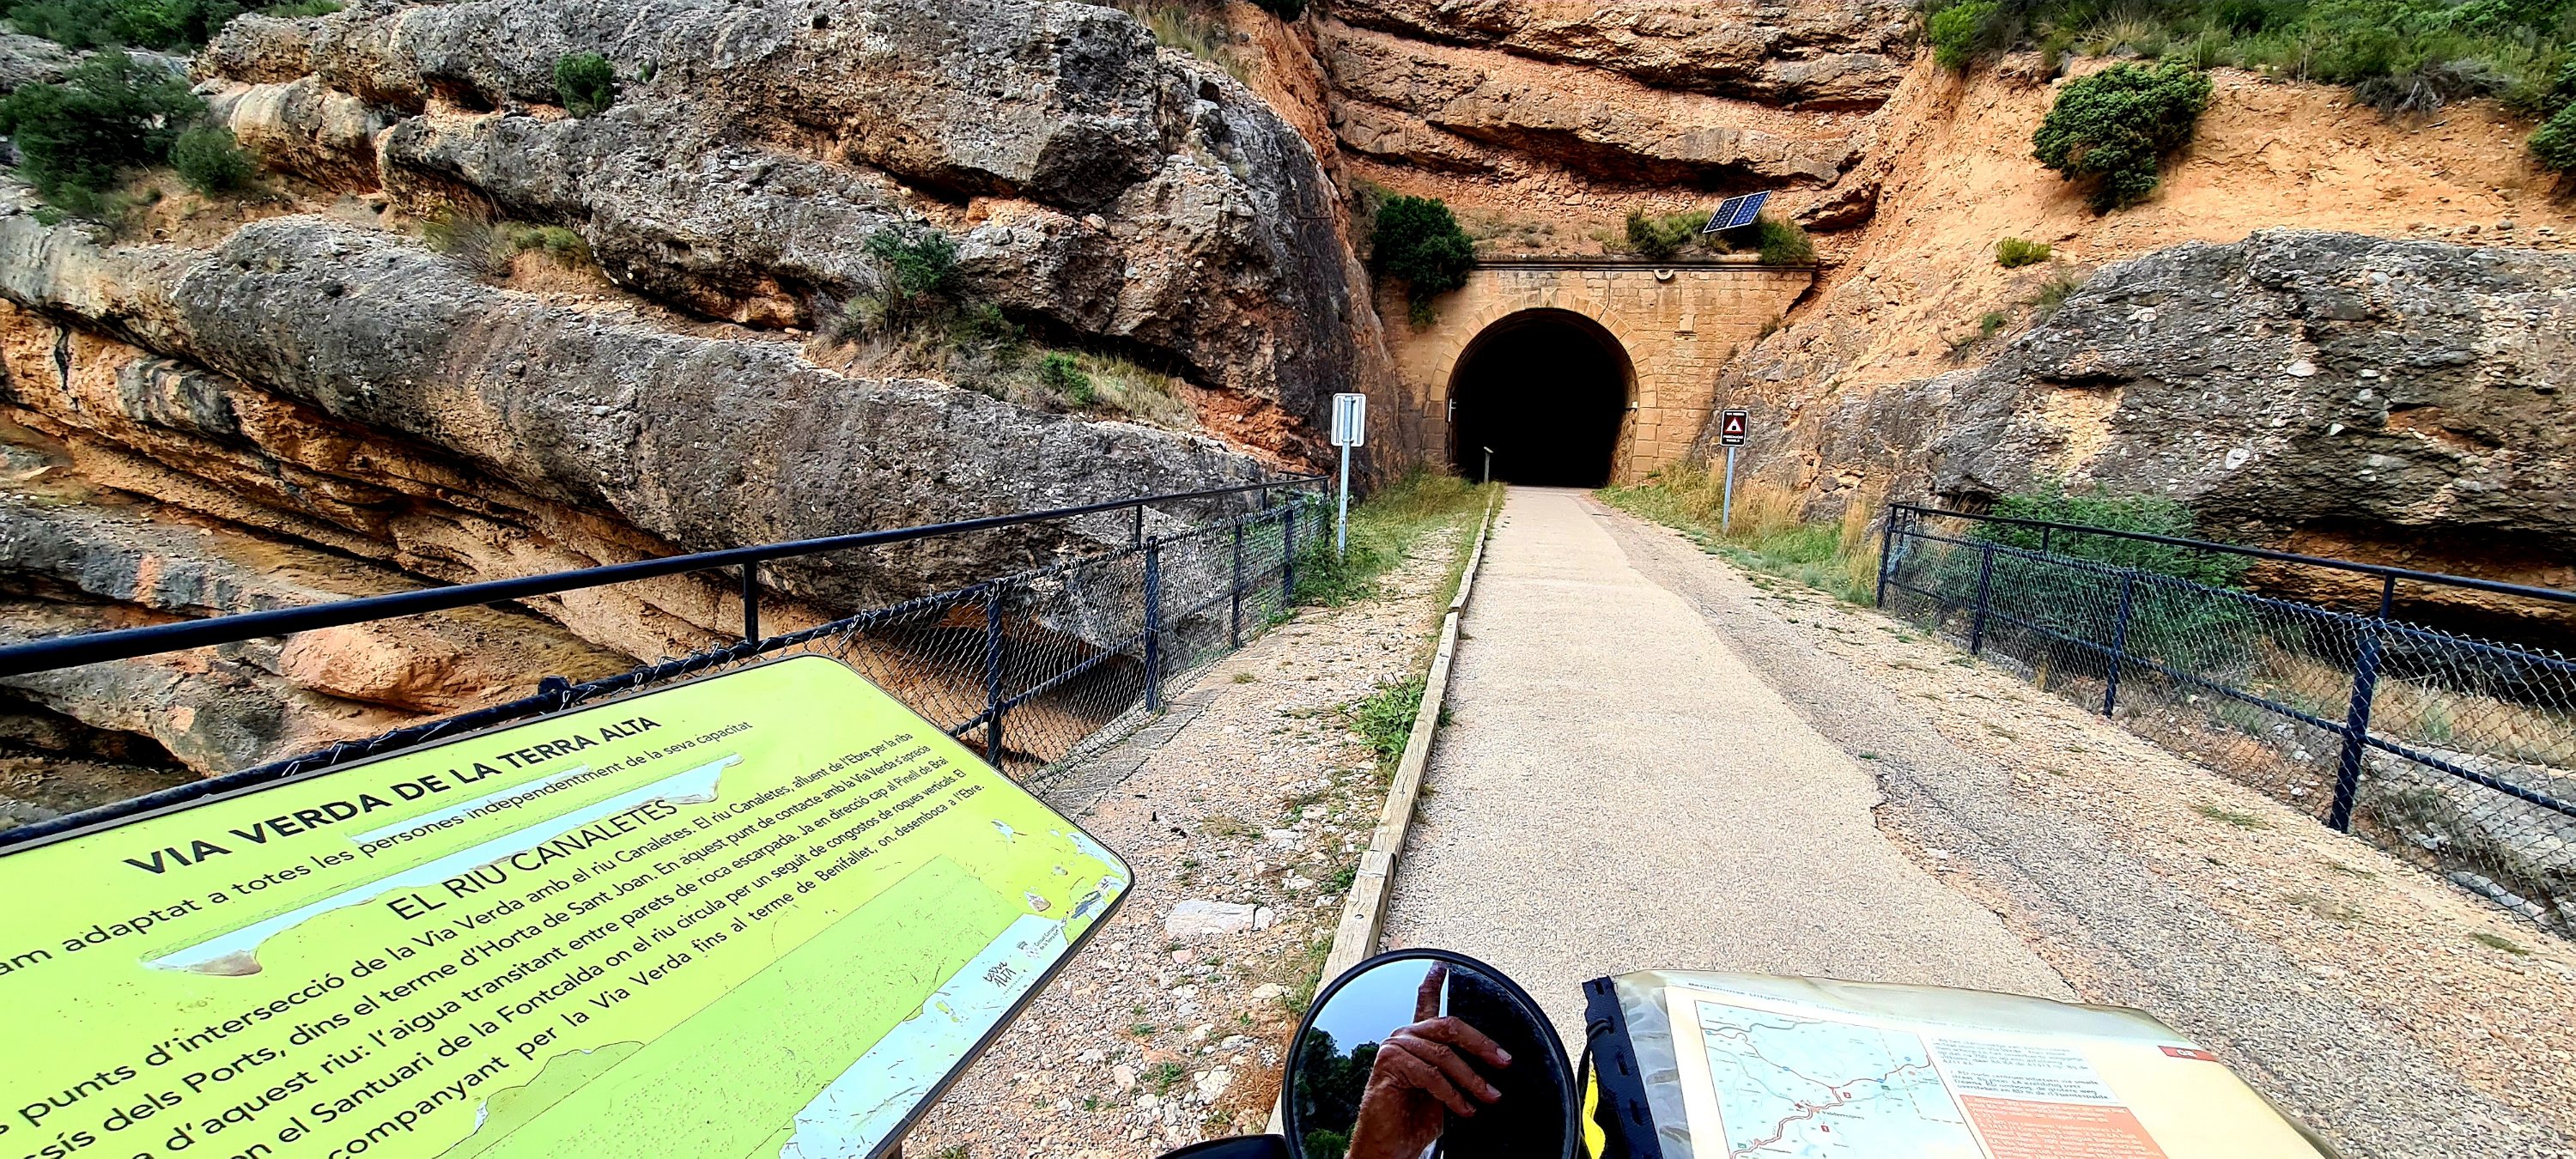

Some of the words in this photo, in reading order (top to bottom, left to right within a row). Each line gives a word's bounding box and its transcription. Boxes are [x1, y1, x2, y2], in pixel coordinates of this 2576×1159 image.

[18, 1066, 137, 1127] punts
[351, 959, 387, 977] de
[385, 947, 416, 961] la
[411, 929, 458, 947] Via
[453, 900, 525, 929] Verda
[526, 879, 570, 902] amb
[573, 868, 591, 883] el
[591, 860, 617, 875] riu
[615, 828, 696, 862] Canaletes.
[692, 816, 713, 829] El
[712, 811, 732, 822] riu
[729, 786, 794, 813] Canaletes,
[793, 768, 830, 788] afluent
[829, 763, 844, 772] de
[870, 744, 887, 756] per
[895, 734, 913, 743] riba
[62, 900, 203, 951] adaptat
[208, 893, 229, 903] a
[231, 865, 311, 894] totes
[310, 852, 355, 868] les
[358, 816, 465, 859] persones
[467, 762, 625, 822] independentment
[626, 756, 647, 767] de
[643, 750, 663, 759] la
[664, 741, 696, 754] seva
[696, 722, 753, 743] capacitat
[123, 840, 233, 874] VIA
[228, 794, 393, 844] VERDA
[390, 774, 451, 801] DE
[449, 763, 502, 784] LA
[495, 735, 599, 768] TERRA
[599, 717, 661, 742] ALTA
[320, 1046, 371, 1074] riu:
[461, 948, 568, 1002] transitant
[569, 923, 619, 950] entre
[620, 895, 675, 928] parets
[676, 883, 698, 896] de
[697, 867, 732, 886] roca
[732, 834, 799, 868] escarpada.
[798, 825, 815, 835] Ja
[814, 817, 831, 828] en
[829, 796, 870, 819] direcció
[869, 789, 888, 800] cap
[887, 781, 897, 791] al
[893, 770, 920, 786] Pinell
[919, 766, 933, 774] de
[386, 894, 447, 920] EL
[441, 865, 507, 898] RIU
[501, 799, 677, 871] CANALETES
[515, 1027, 556, 1060] per
[561, 1012, 590, 1027] la
[588, 988, 630, 1008] Via
[629, 953, 692, 986] Verda
[691, 932, 727, 953] fins
[731, 917, 747, 931] al
[748, 894, 794, 920] terme
[797, 882, 816, 893] de
[814, 846, 878, 881] Benifallet,
[894, 804, 948, 836] desemboca
[104, 1091, 182, 1132] dels
[182, 1048, 286, 1093] Ports,
[289, 1014, 350, 1045] dins
[354, 995, 380, 1015] el
[380, 965, 458, 1002] terme
[543, 913, 570, 927] de
[568, 892, 613, 915] Sant
[612, 874, 658, 895] Joan.
[653, 862, 681, 875] En
[679, 839, 728, 865] aquest
[726, 825, 759, 846] punt
[758, 817, 776, 828] de
[775, 797, 823, 820] contacte
[822, 784, 846, 798] amb
[850, 774, 872, 783] Via
[865, 761, 897, 775] Verda
[279, 1117, 310, 1143] el
[311, 1052, 434, 1123] Santuari
[438, 1036, 472, 1057] de
[469, 1022, 500, 1037] la
[496, 966, 605, 1022] Fontcalda
[606, 951, 632, 967] on
[633, 936, 652, 952] el
[651, 926, 677, 942] riu
[677, 900, 726, 928] circula
[726, 885, 750, 906] per
[751, 876, 772, 888] un
[771, 854, 811, 878] seguit
[809, 846, 827, 857] de
[827, 817, 879, 847] congostos
[878, 810, 894, 820] de
[892, 794, 924, 813] roques
[921, 776, 956, 795] verticals.
[953, 768, 966, 778] El
